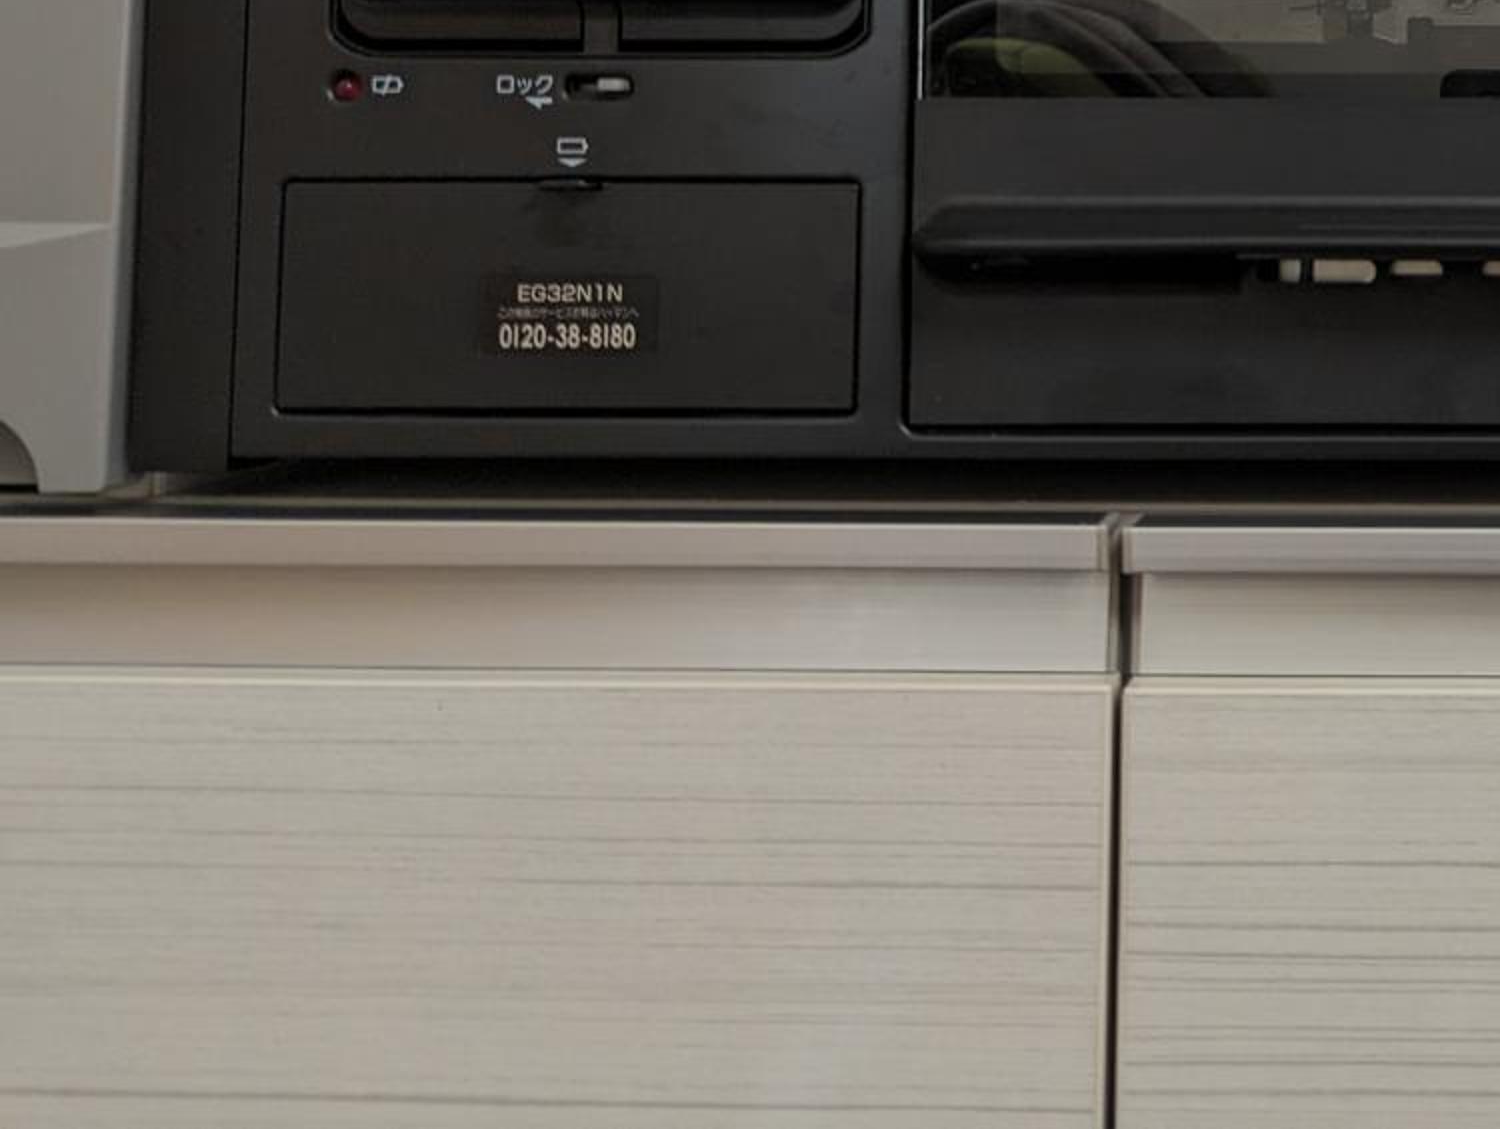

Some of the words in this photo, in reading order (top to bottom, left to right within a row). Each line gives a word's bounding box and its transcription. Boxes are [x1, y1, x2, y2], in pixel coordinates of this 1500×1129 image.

[496, 74, 554, 95] ロック
[516, 283, 624, 303] EG32N1N
[499, 323, 637, 349] 0120-38-8180
